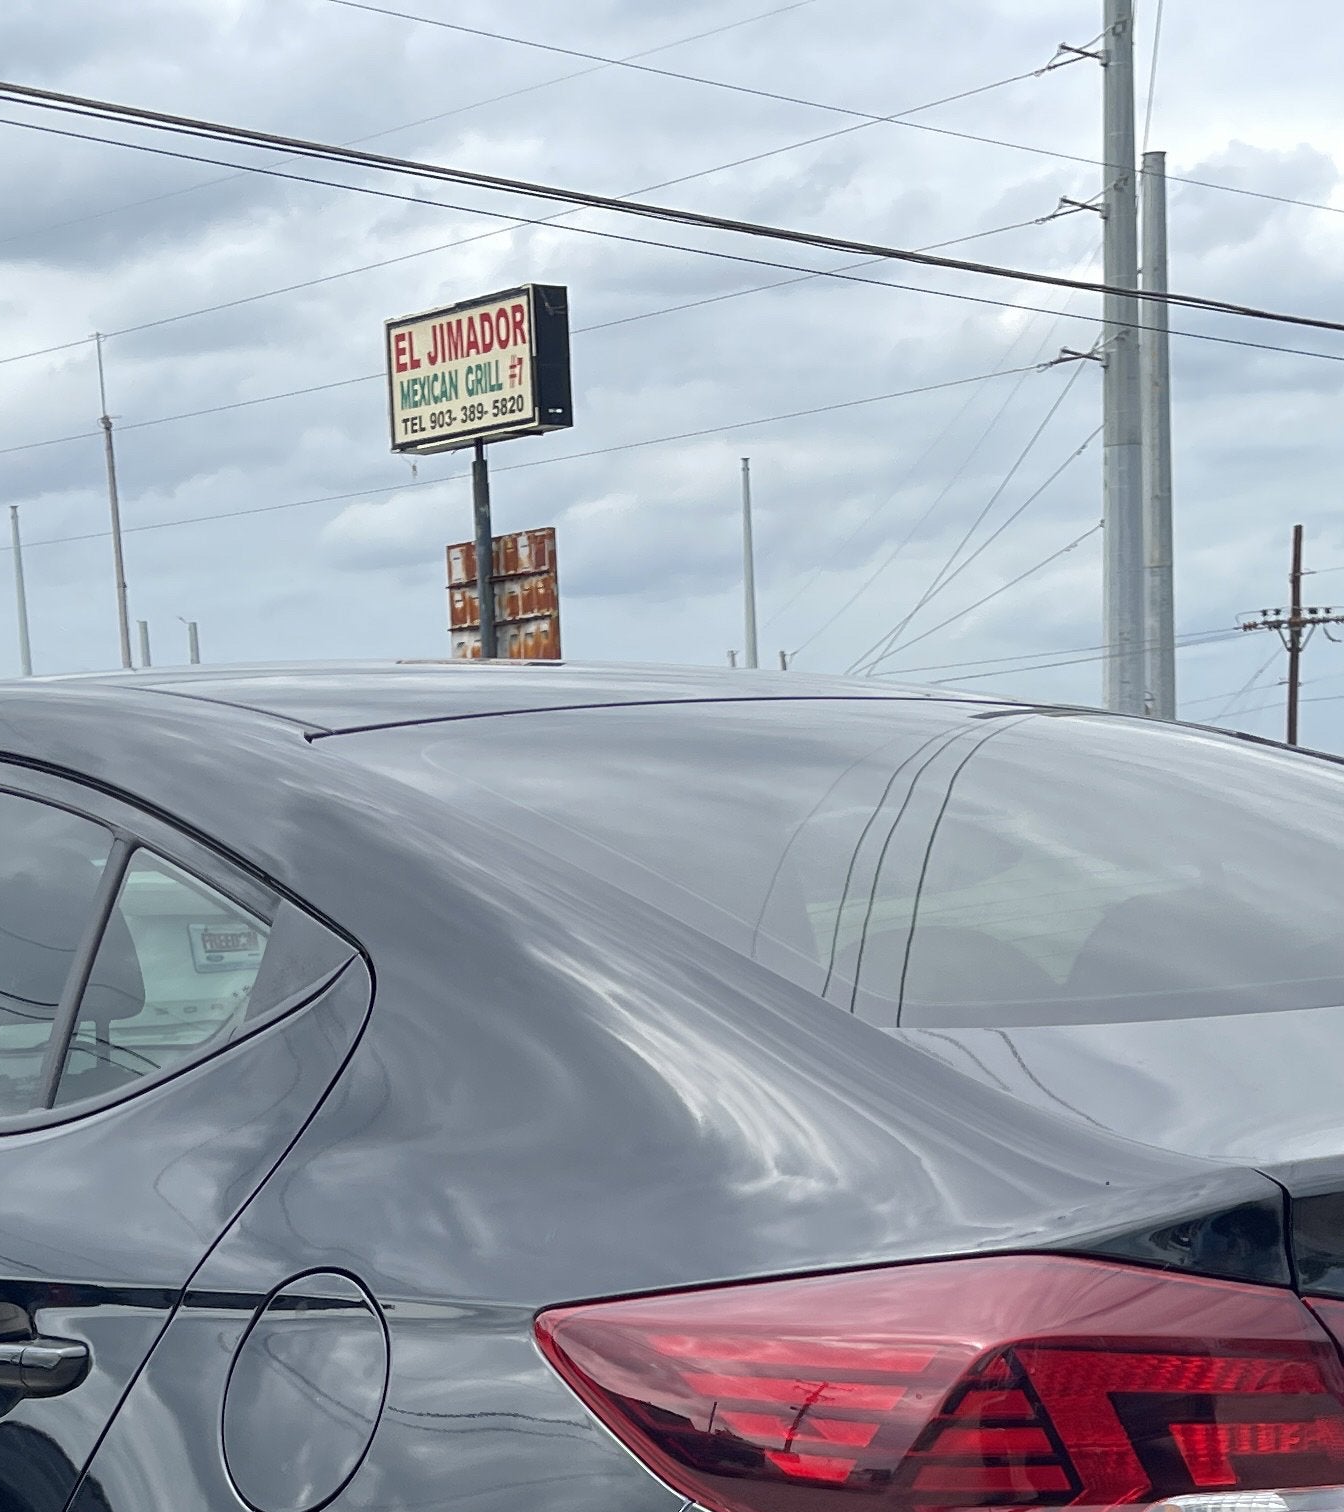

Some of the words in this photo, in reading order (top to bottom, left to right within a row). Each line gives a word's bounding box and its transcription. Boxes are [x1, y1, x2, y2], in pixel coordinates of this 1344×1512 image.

[394, 331, 421, 374] EL
[427, 303, 527, 366] JIMADOR
[400, 369, 459, 411] MEXICAN
[465, 359, 503, 398] GRILL
[401, 415, 426, 436] TEL
